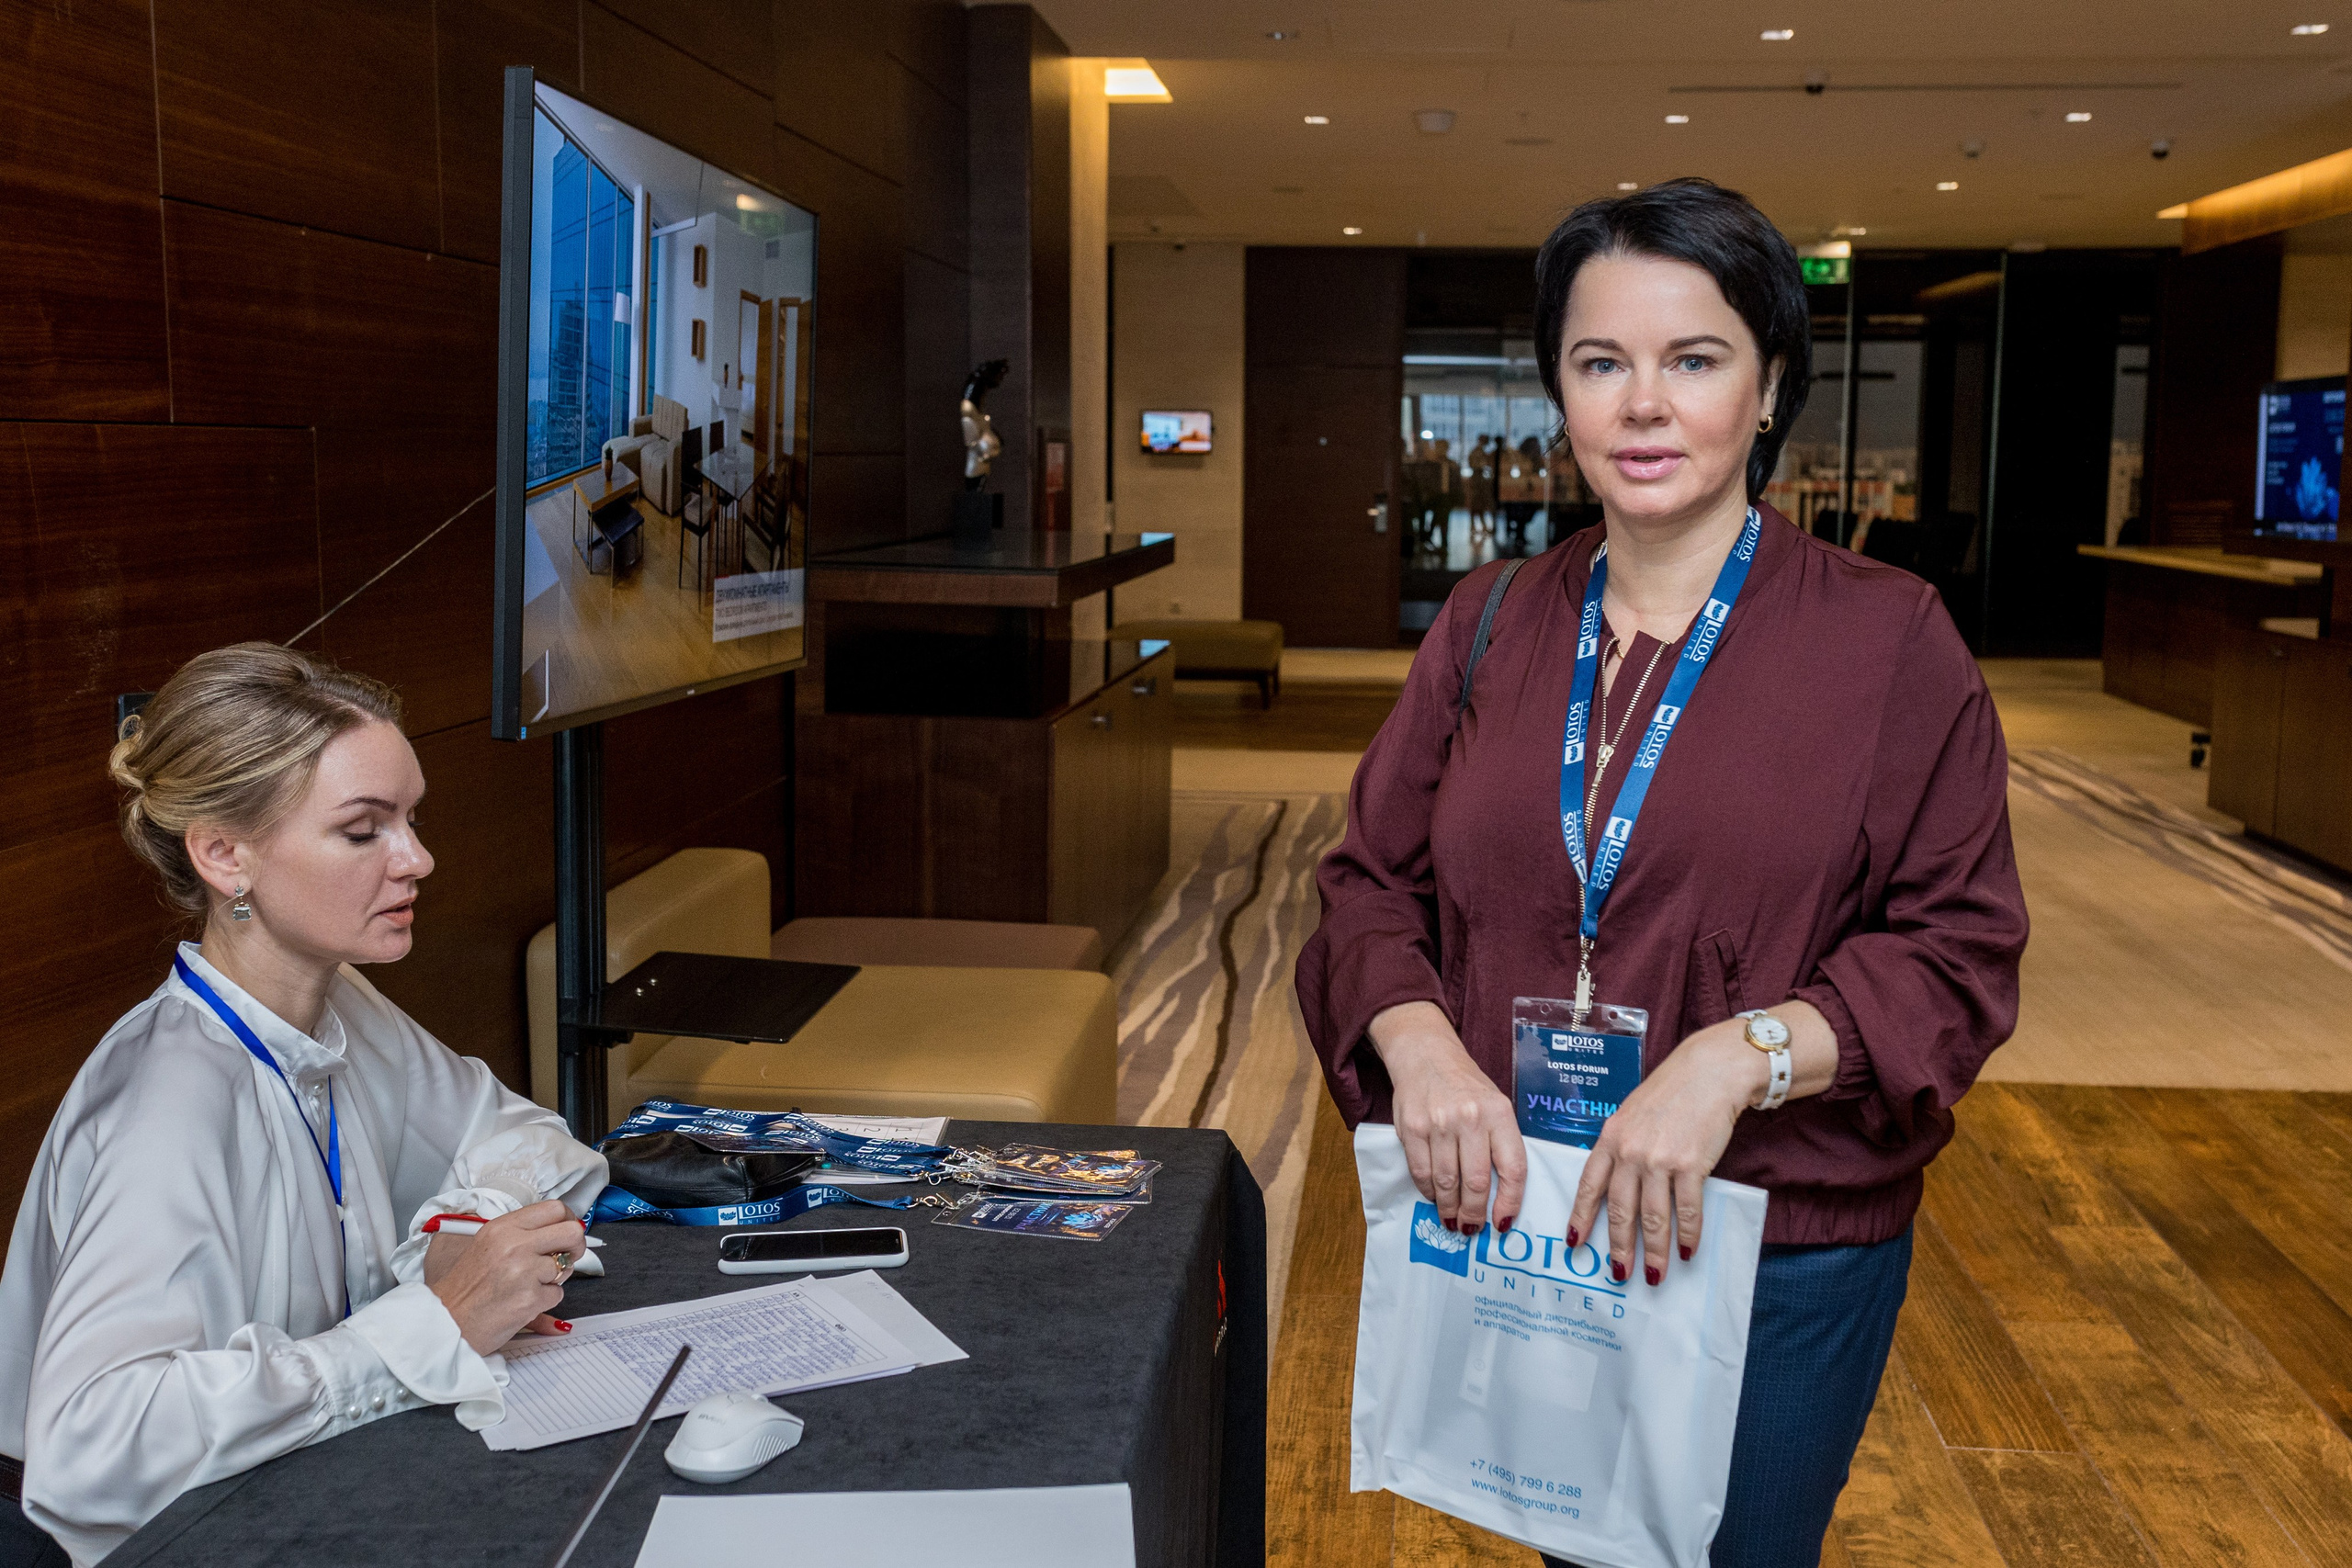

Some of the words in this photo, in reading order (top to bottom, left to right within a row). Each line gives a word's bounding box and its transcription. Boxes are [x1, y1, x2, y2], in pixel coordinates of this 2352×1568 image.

[1738, 521, 1759, 562] LOTOS
[1580, 600, 1597, 641] LOTOS
[1683, 616, 1706, 659] UNITED
[1691, 619, 1722, 663] LOTOS
[1566, 702, 1583, 745] LOTOS
[1641, 724, 1671, 769] LOTOS
[1564, 811, 1581, 863] LOTOS
[1598, 839, 1625, 891] LOTOS
[1568, 1035, 1604, 1049] LOTOS
[1547, 1061, 1576, 1072] LOTOS
[1577, 1064, 1609, 1075] FORUM
[1585, 1076, 1600, 1087] 23
[1527, 1093, 1622, 1118] УЧАСТНИ
[739, 1202, 781, 1220] LOTOS
[1474, 1269, 1625, 1319] UNITED
[1475, 1295, 1542, 1321] официальный
[1544, 1312, 1616, 1339] дистрибьютор
[1475, 1306, 1569, 1337] профессиональной
[1571, 1329, 1623, 1352] косметики
[1483, 1319, 1531, 1342] аппаратов
[1470, 1459, 1486, 1471] +7
[1488, 1462, 1516, 1487] (495)
[1520, 1475, 1543, 1491] 799
[1545, 1481, 1555, 1494] 6
[1557, 1483, 1582, 1499] 288
[1471, 1478, 1580, 1520] www.lotosgroup.org
